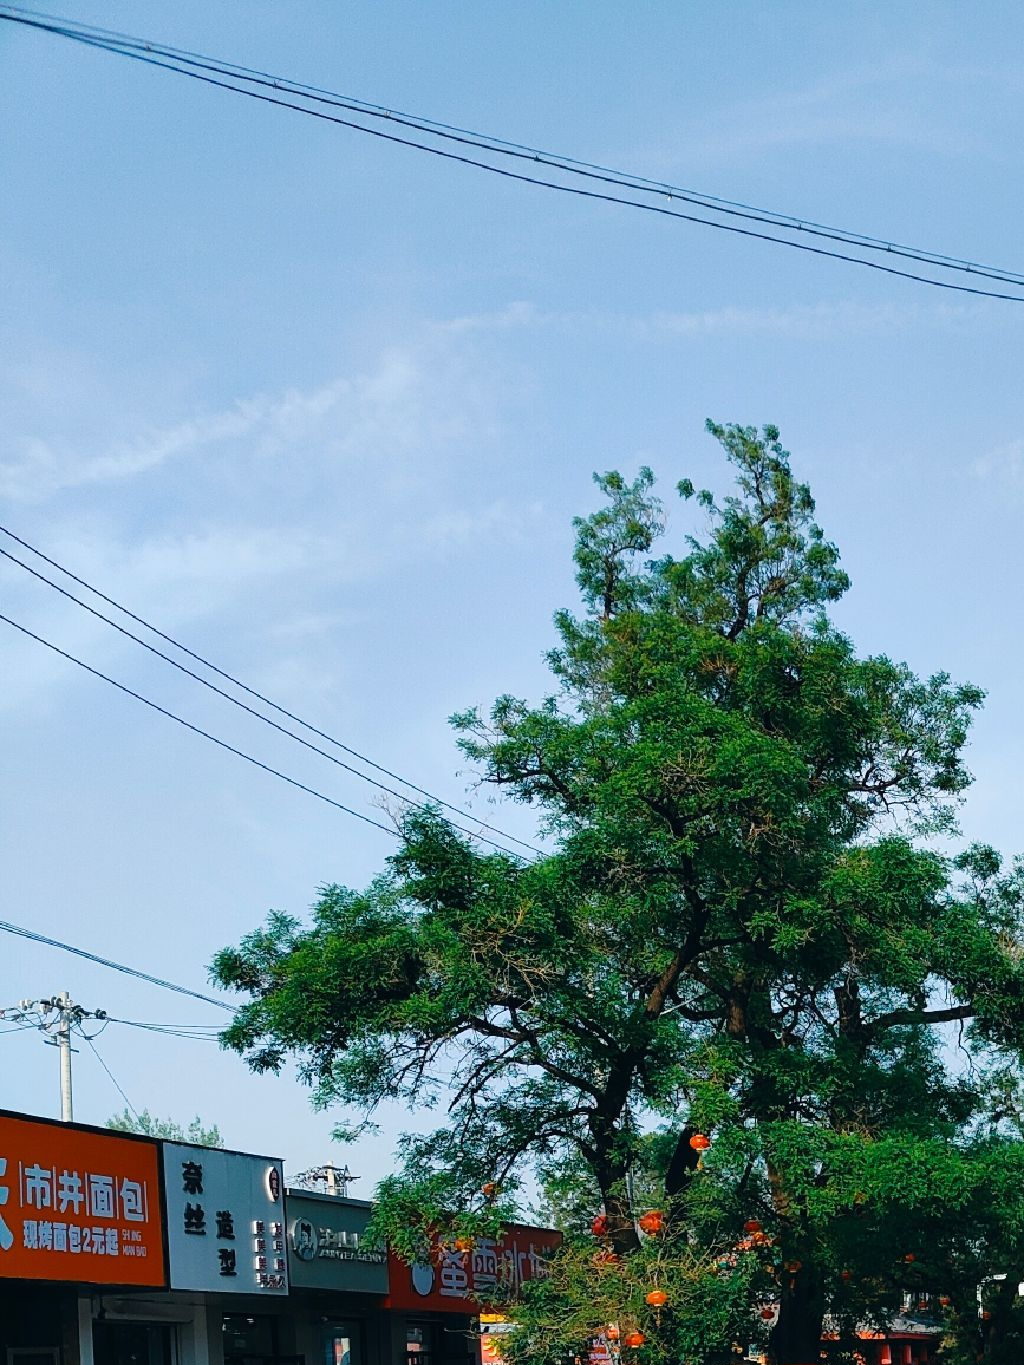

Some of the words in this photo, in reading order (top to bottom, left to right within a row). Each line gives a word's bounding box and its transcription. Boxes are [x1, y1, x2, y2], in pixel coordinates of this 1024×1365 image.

[25, 1164, 145, 1222] 市井面包
[23, 1220, 119, 1256] 现烤面包2元起
